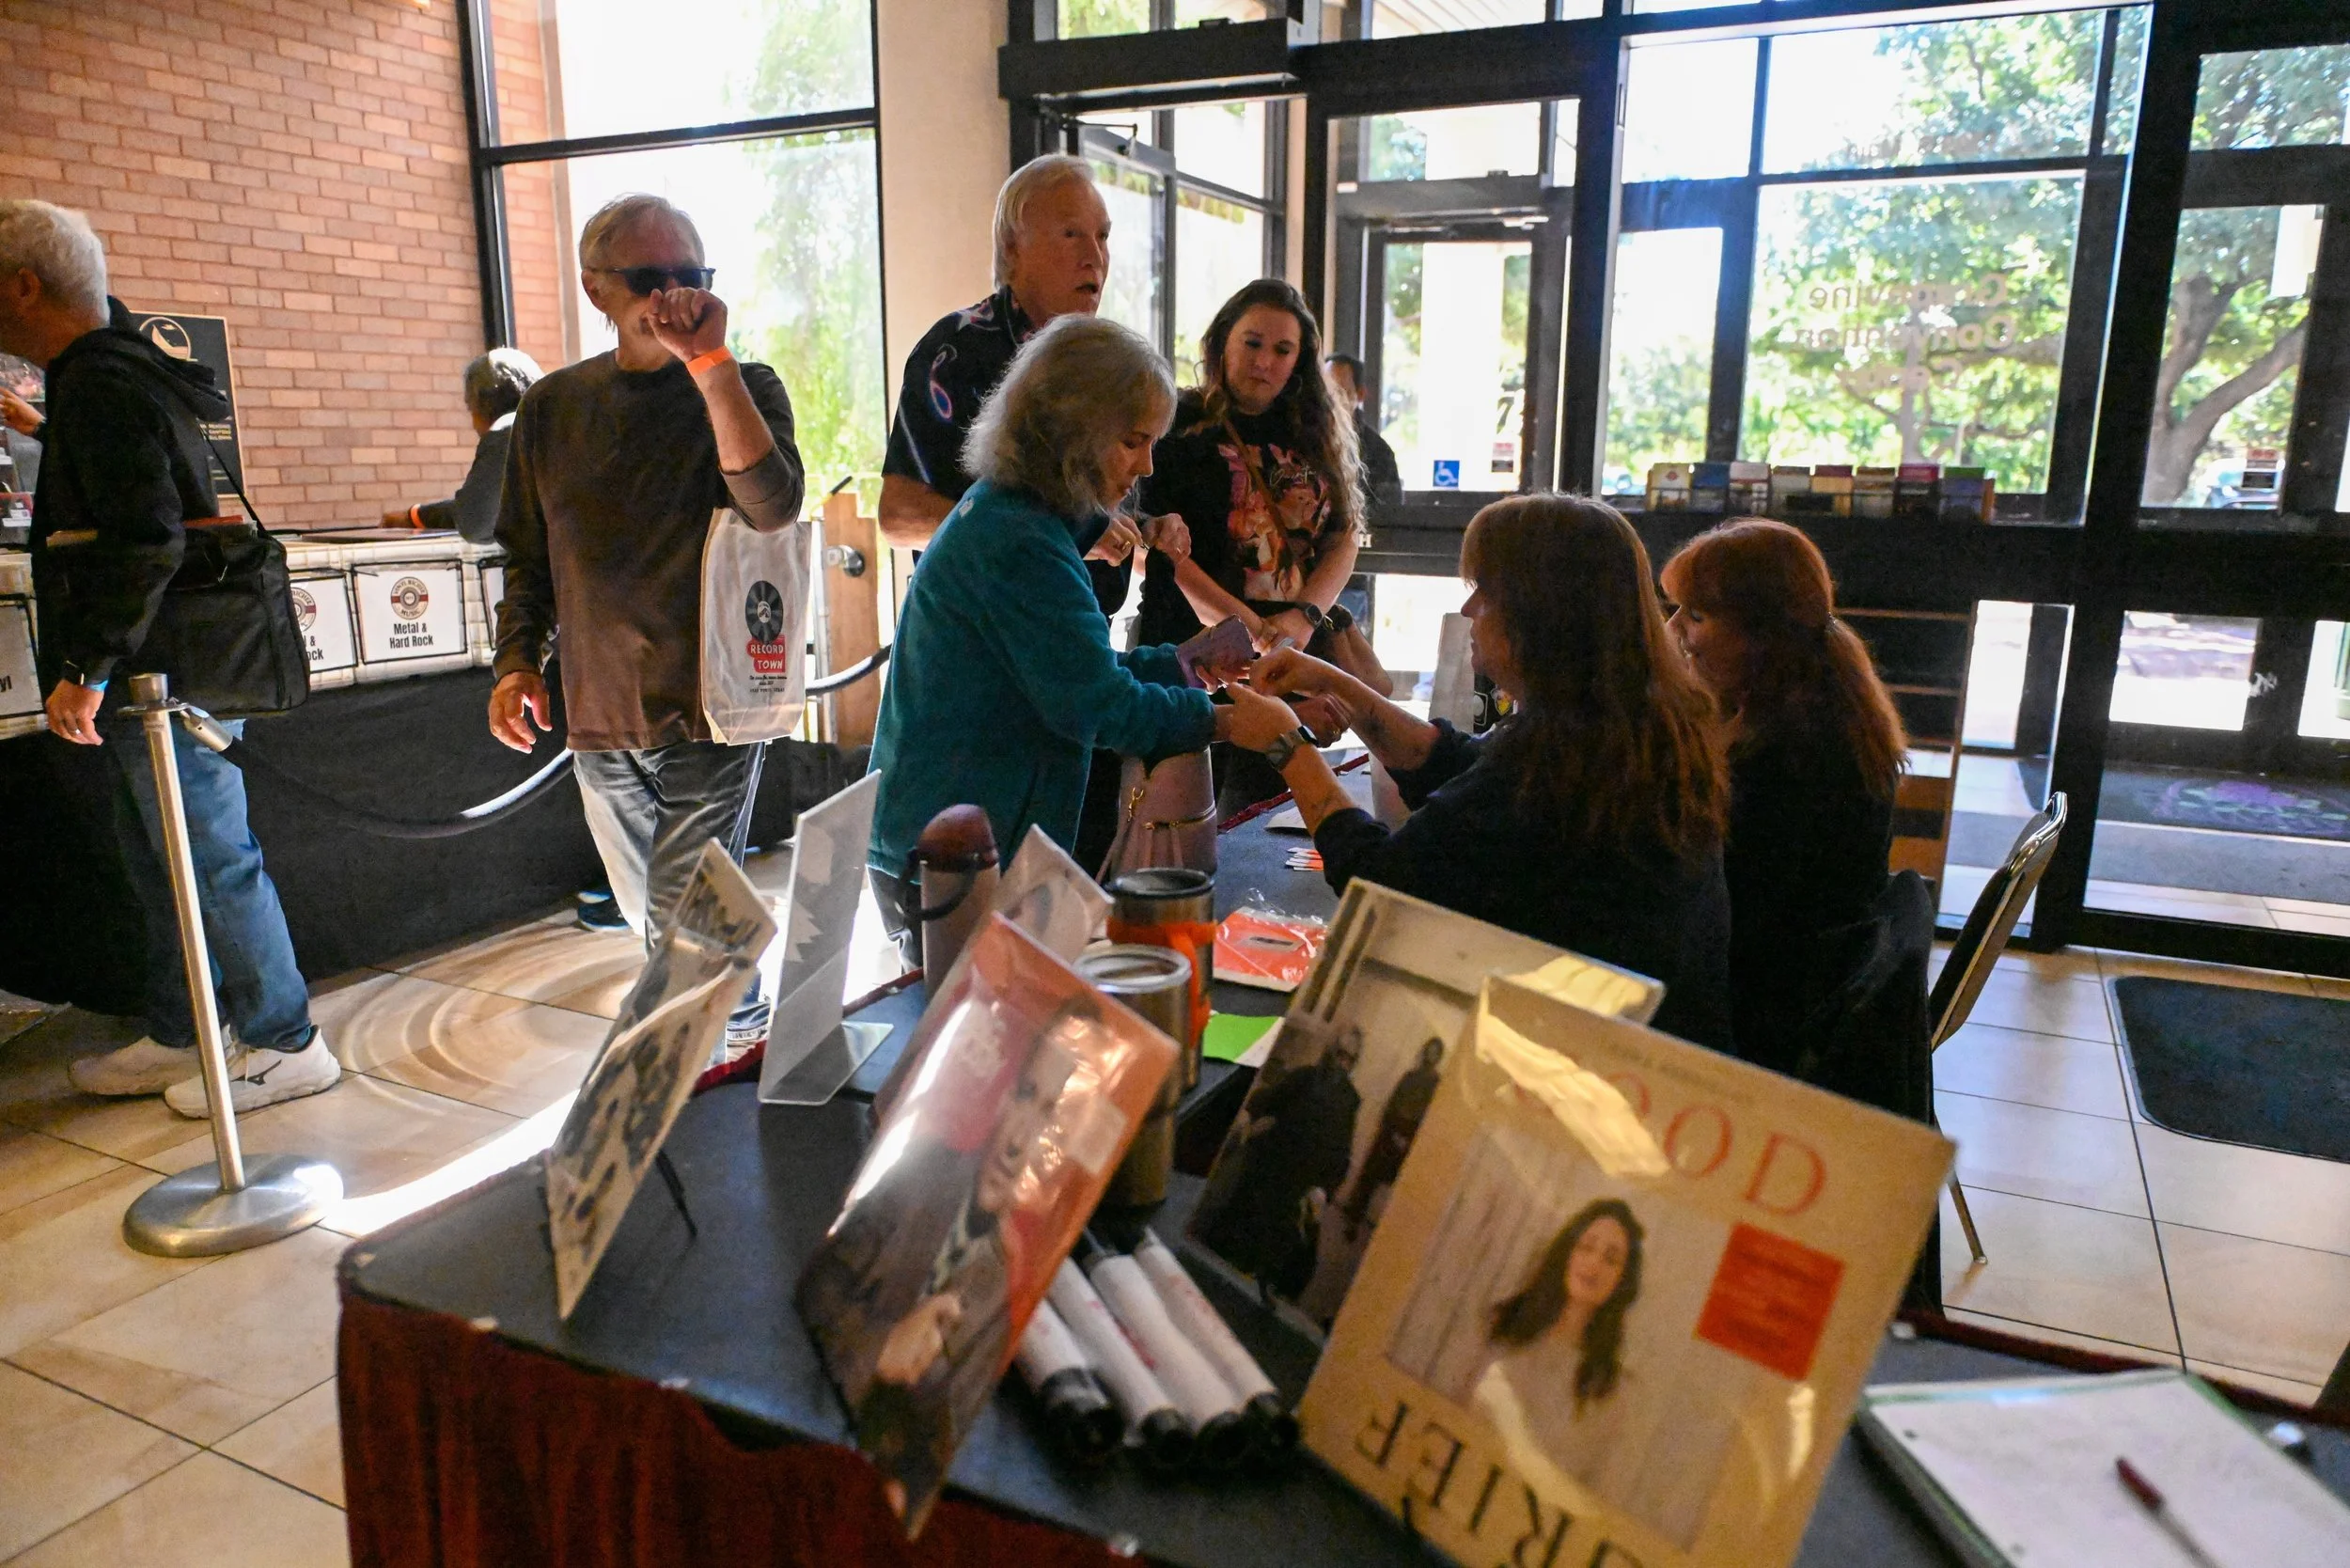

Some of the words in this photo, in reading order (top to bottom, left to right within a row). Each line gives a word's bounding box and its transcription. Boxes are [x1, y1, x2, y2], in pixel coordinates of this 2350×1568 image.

[393, 622, 419, 635] Metal
[421, 622, 428, 633] &
[309, 635, 316, 647] &
[389, 636, 410, 649] Hard
[412, 635, 433, 647] Rock
[306, 648, 324, 661] ock
[750, 644, 784, 654] RECORD
[757, 659, 783, 669] TOWN
